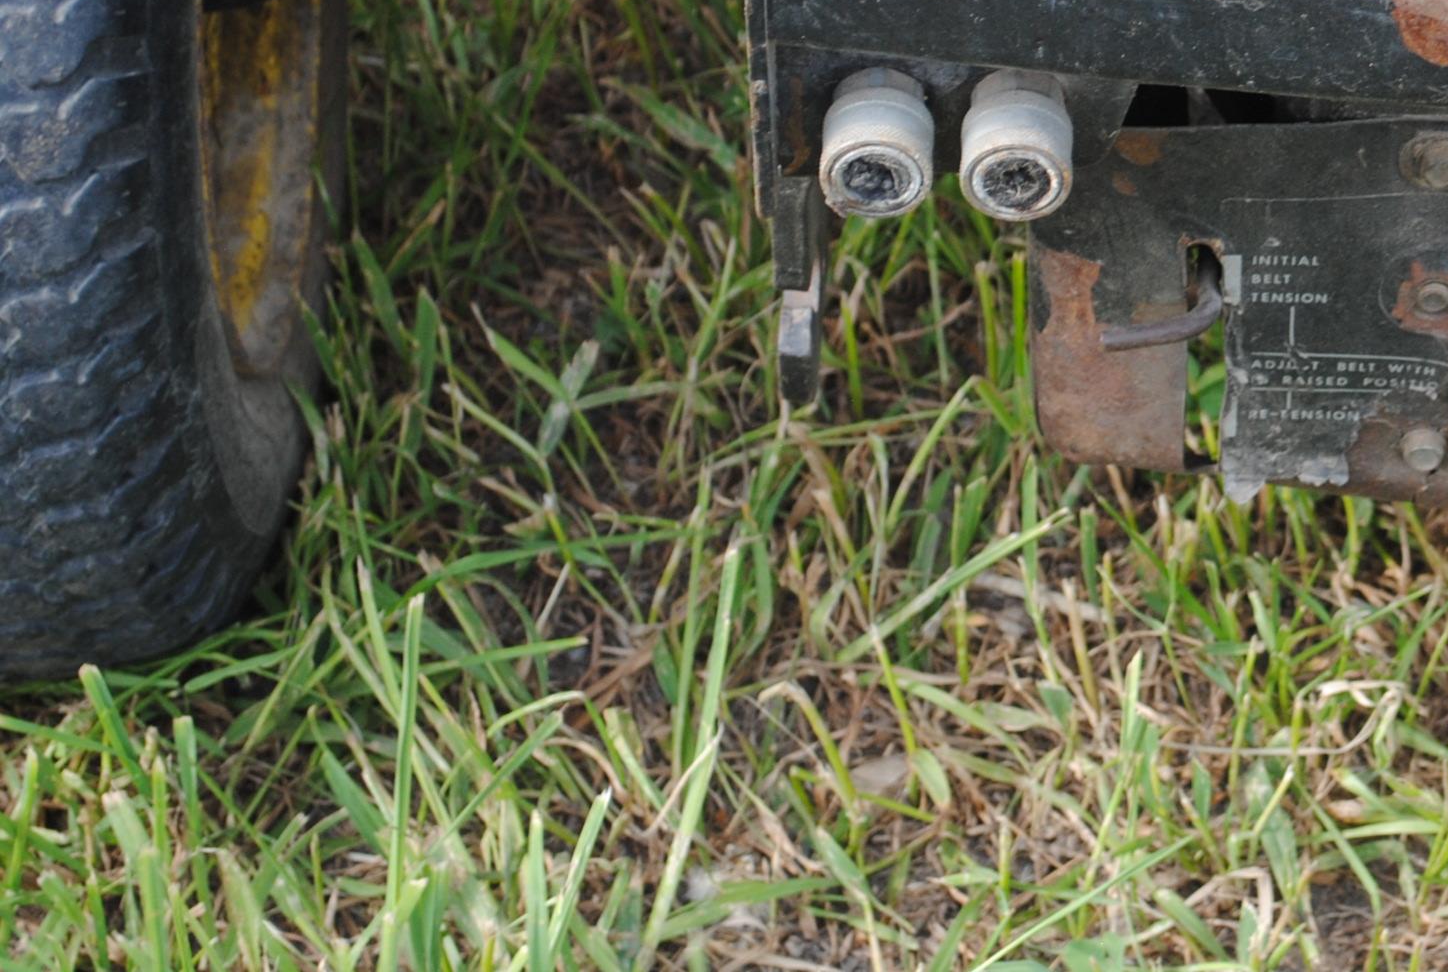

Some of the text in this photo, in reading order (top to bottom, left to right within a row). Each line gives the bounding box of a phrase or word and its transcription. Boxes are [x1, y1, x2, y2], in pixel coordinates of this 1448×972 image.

[1252, 255, 1319, 266] INITIAL
[1251, 273, 1291, 285] BELT
[1251, 292, 1328, 304] TENSION
[1337, 361, 1376, 373] BELT
[1282, 375, 1348, 387] RAISED
